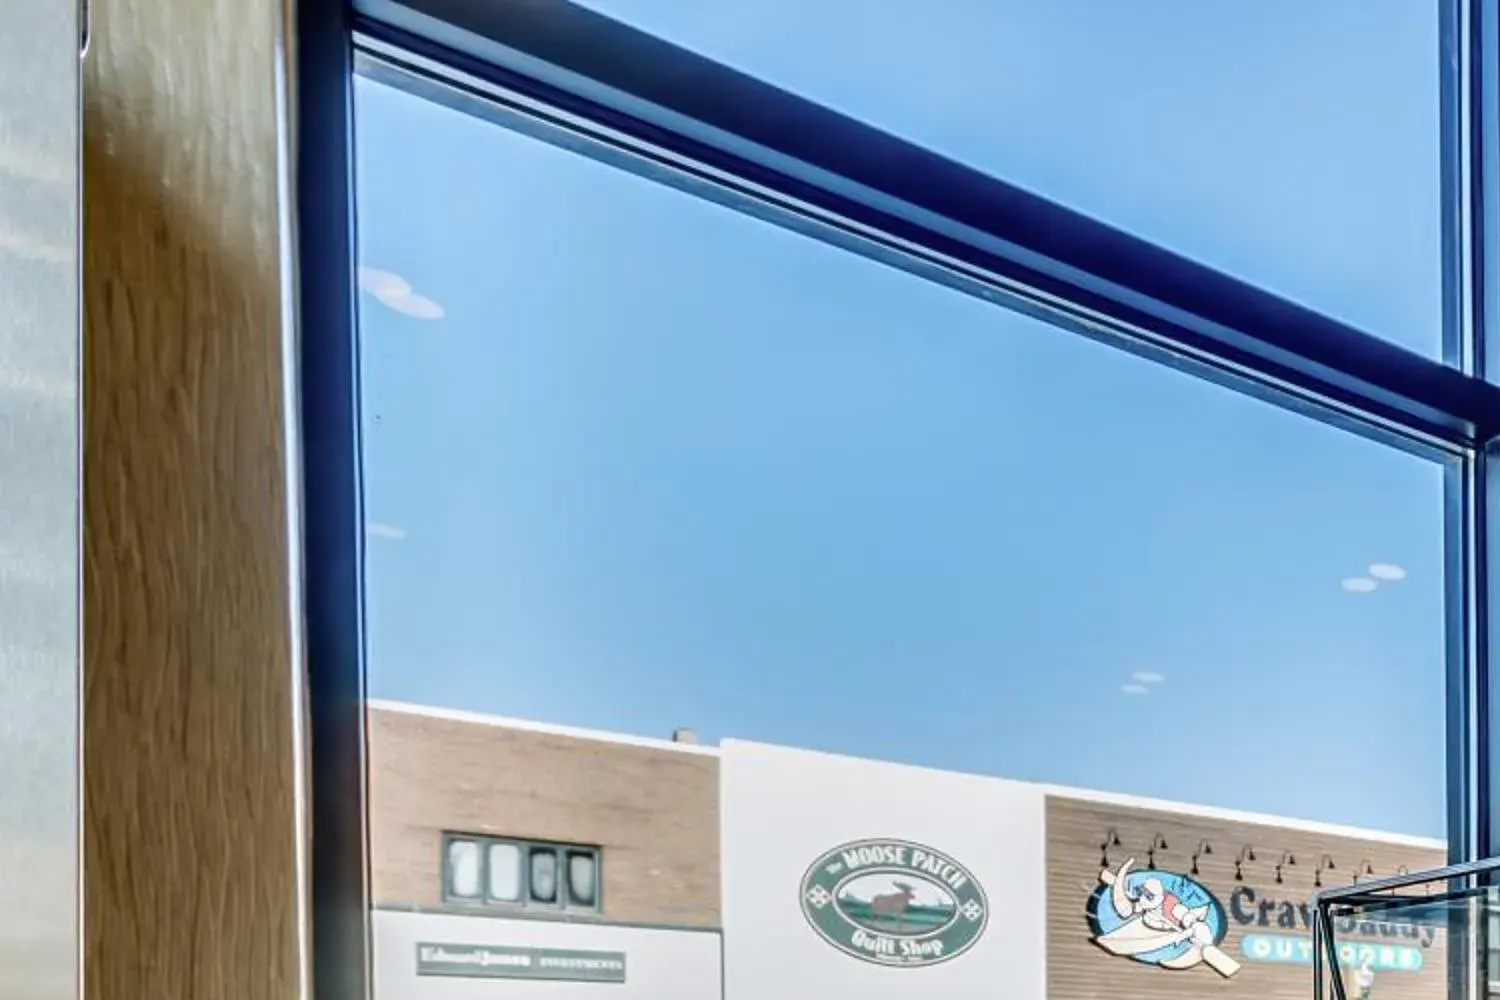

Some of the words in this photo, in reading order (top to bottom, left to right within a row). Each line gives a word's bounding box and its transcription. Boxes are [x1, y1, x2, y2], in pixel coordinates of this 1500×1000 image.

[911, 850, 968, 889] PATCH
[1230, 885, 1436, 948] Craay
[851, 928, 895, 954] Quilt
[899, 937, 944, 957] Shop
[1252, 939, 1415, 963] OUTOORS
